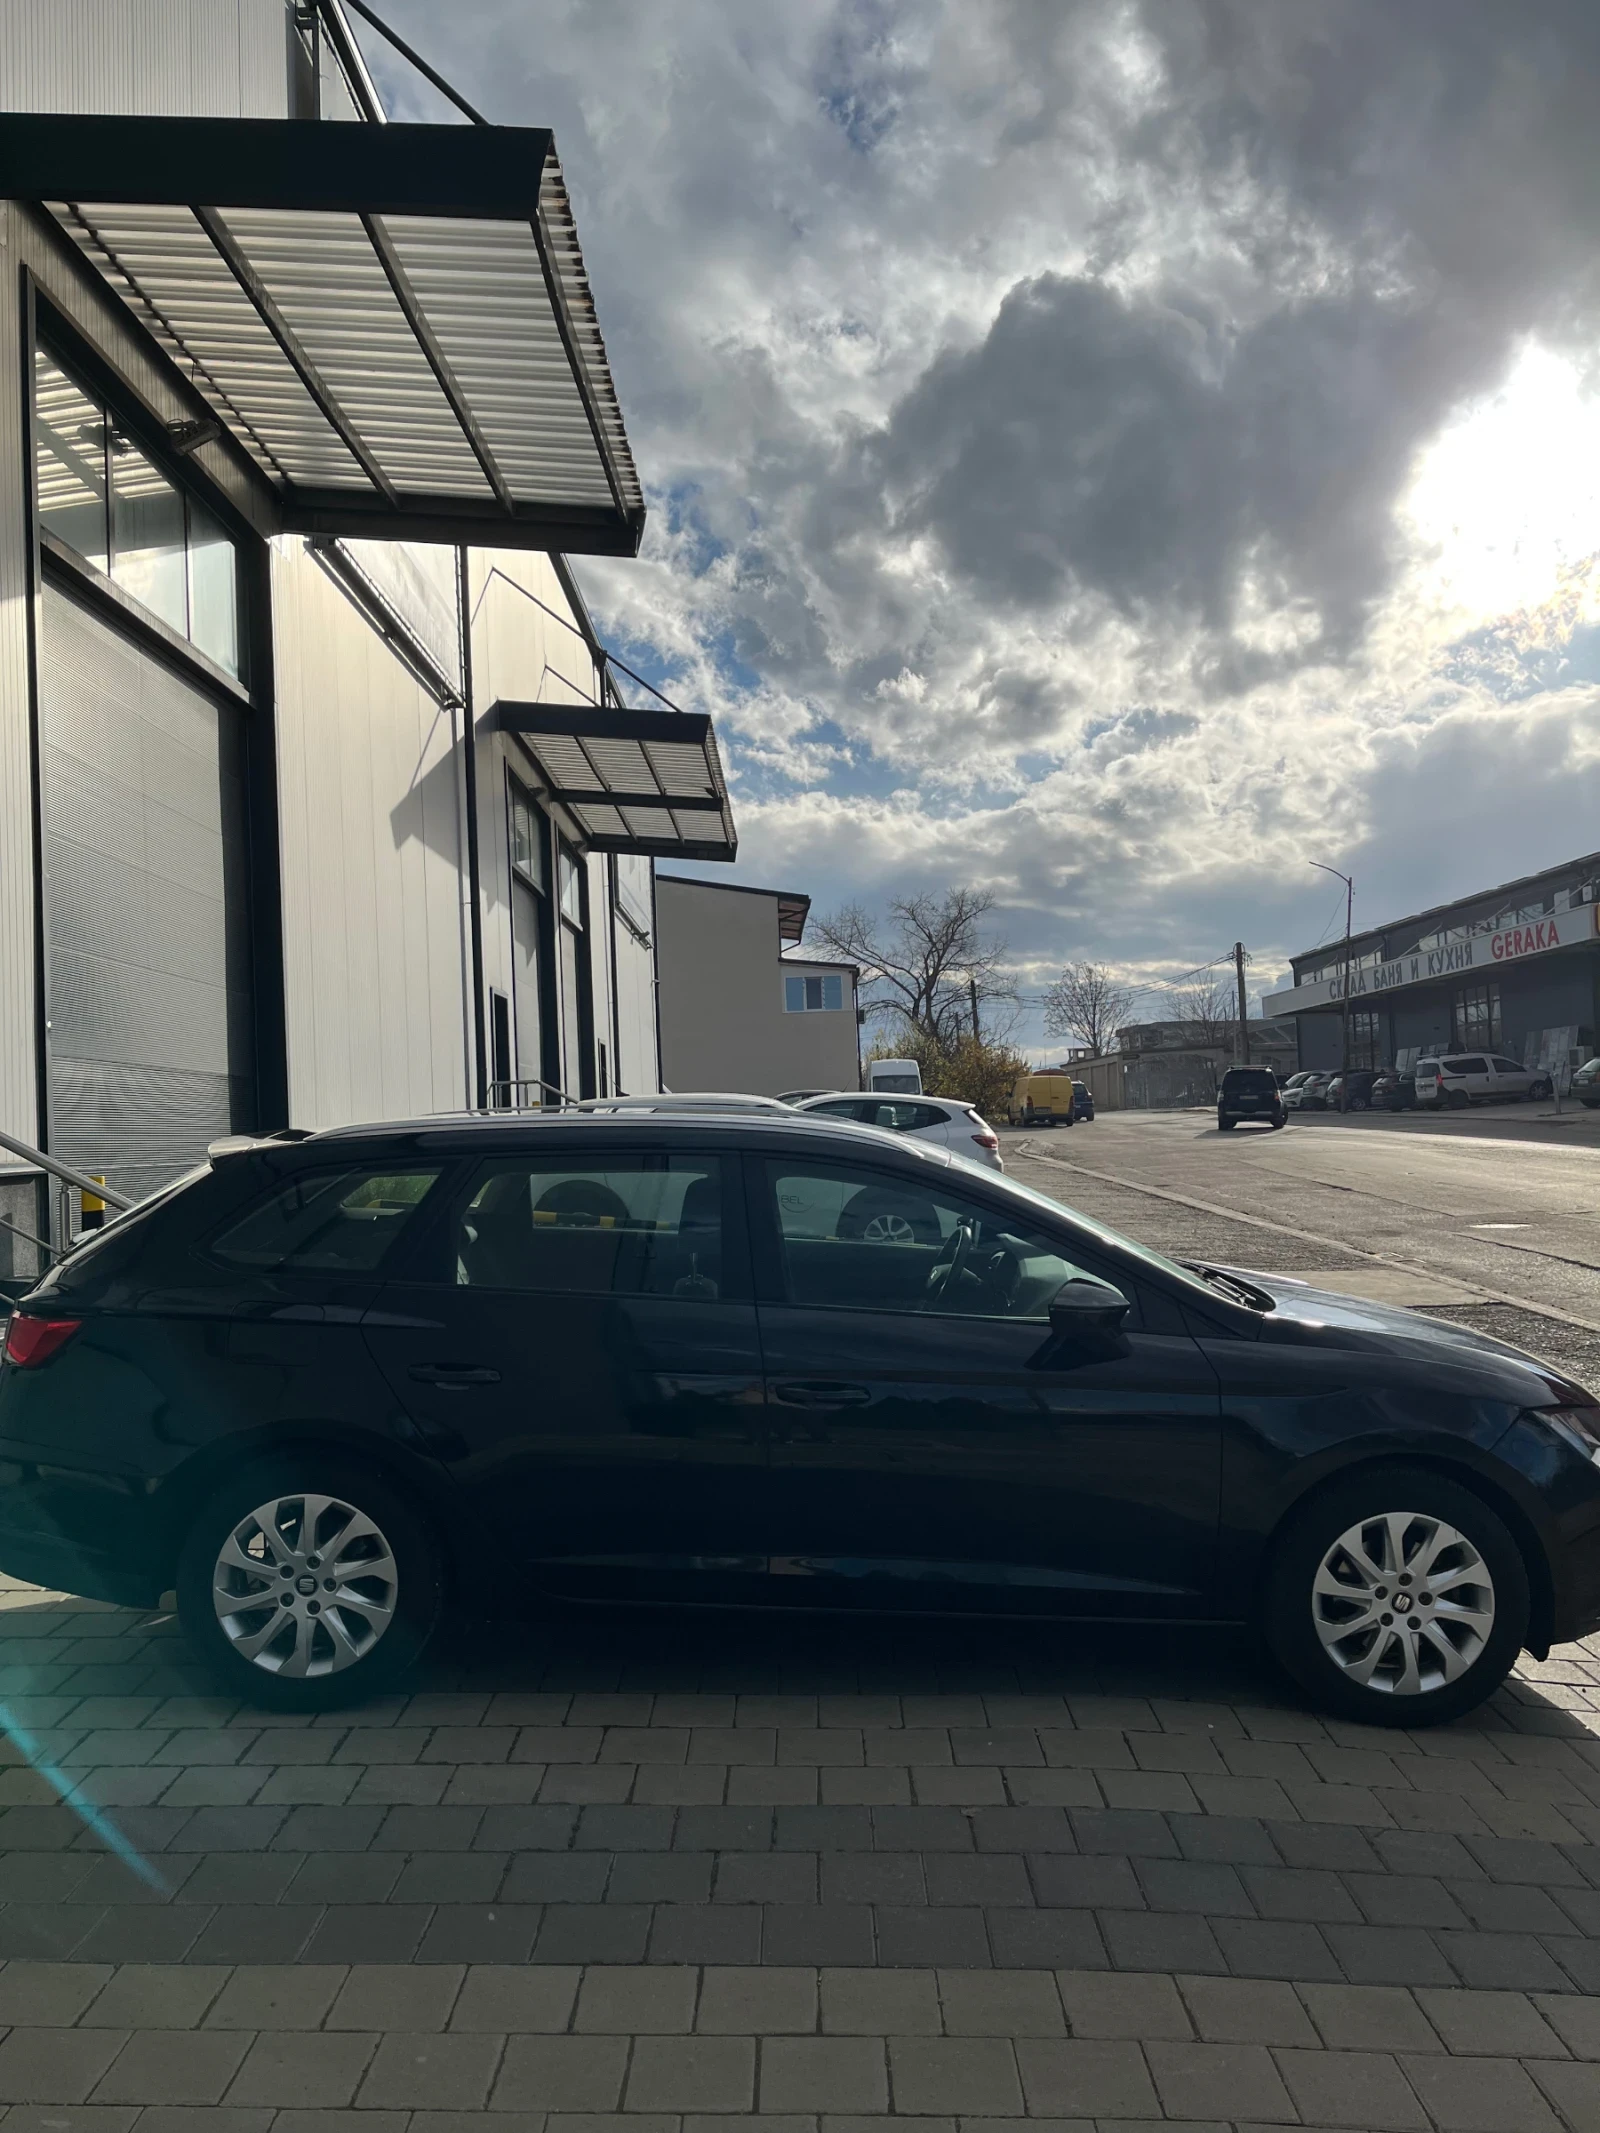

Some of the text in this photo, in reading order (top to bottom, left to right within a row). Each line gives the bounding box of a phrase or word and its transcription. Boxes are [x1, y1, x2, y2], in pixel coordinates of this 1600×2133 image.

[1491, 919, 1560, 960] GERAKA
[1329, 941, 1473, 1000] СКАД БАНЯ И КУХНЯ
